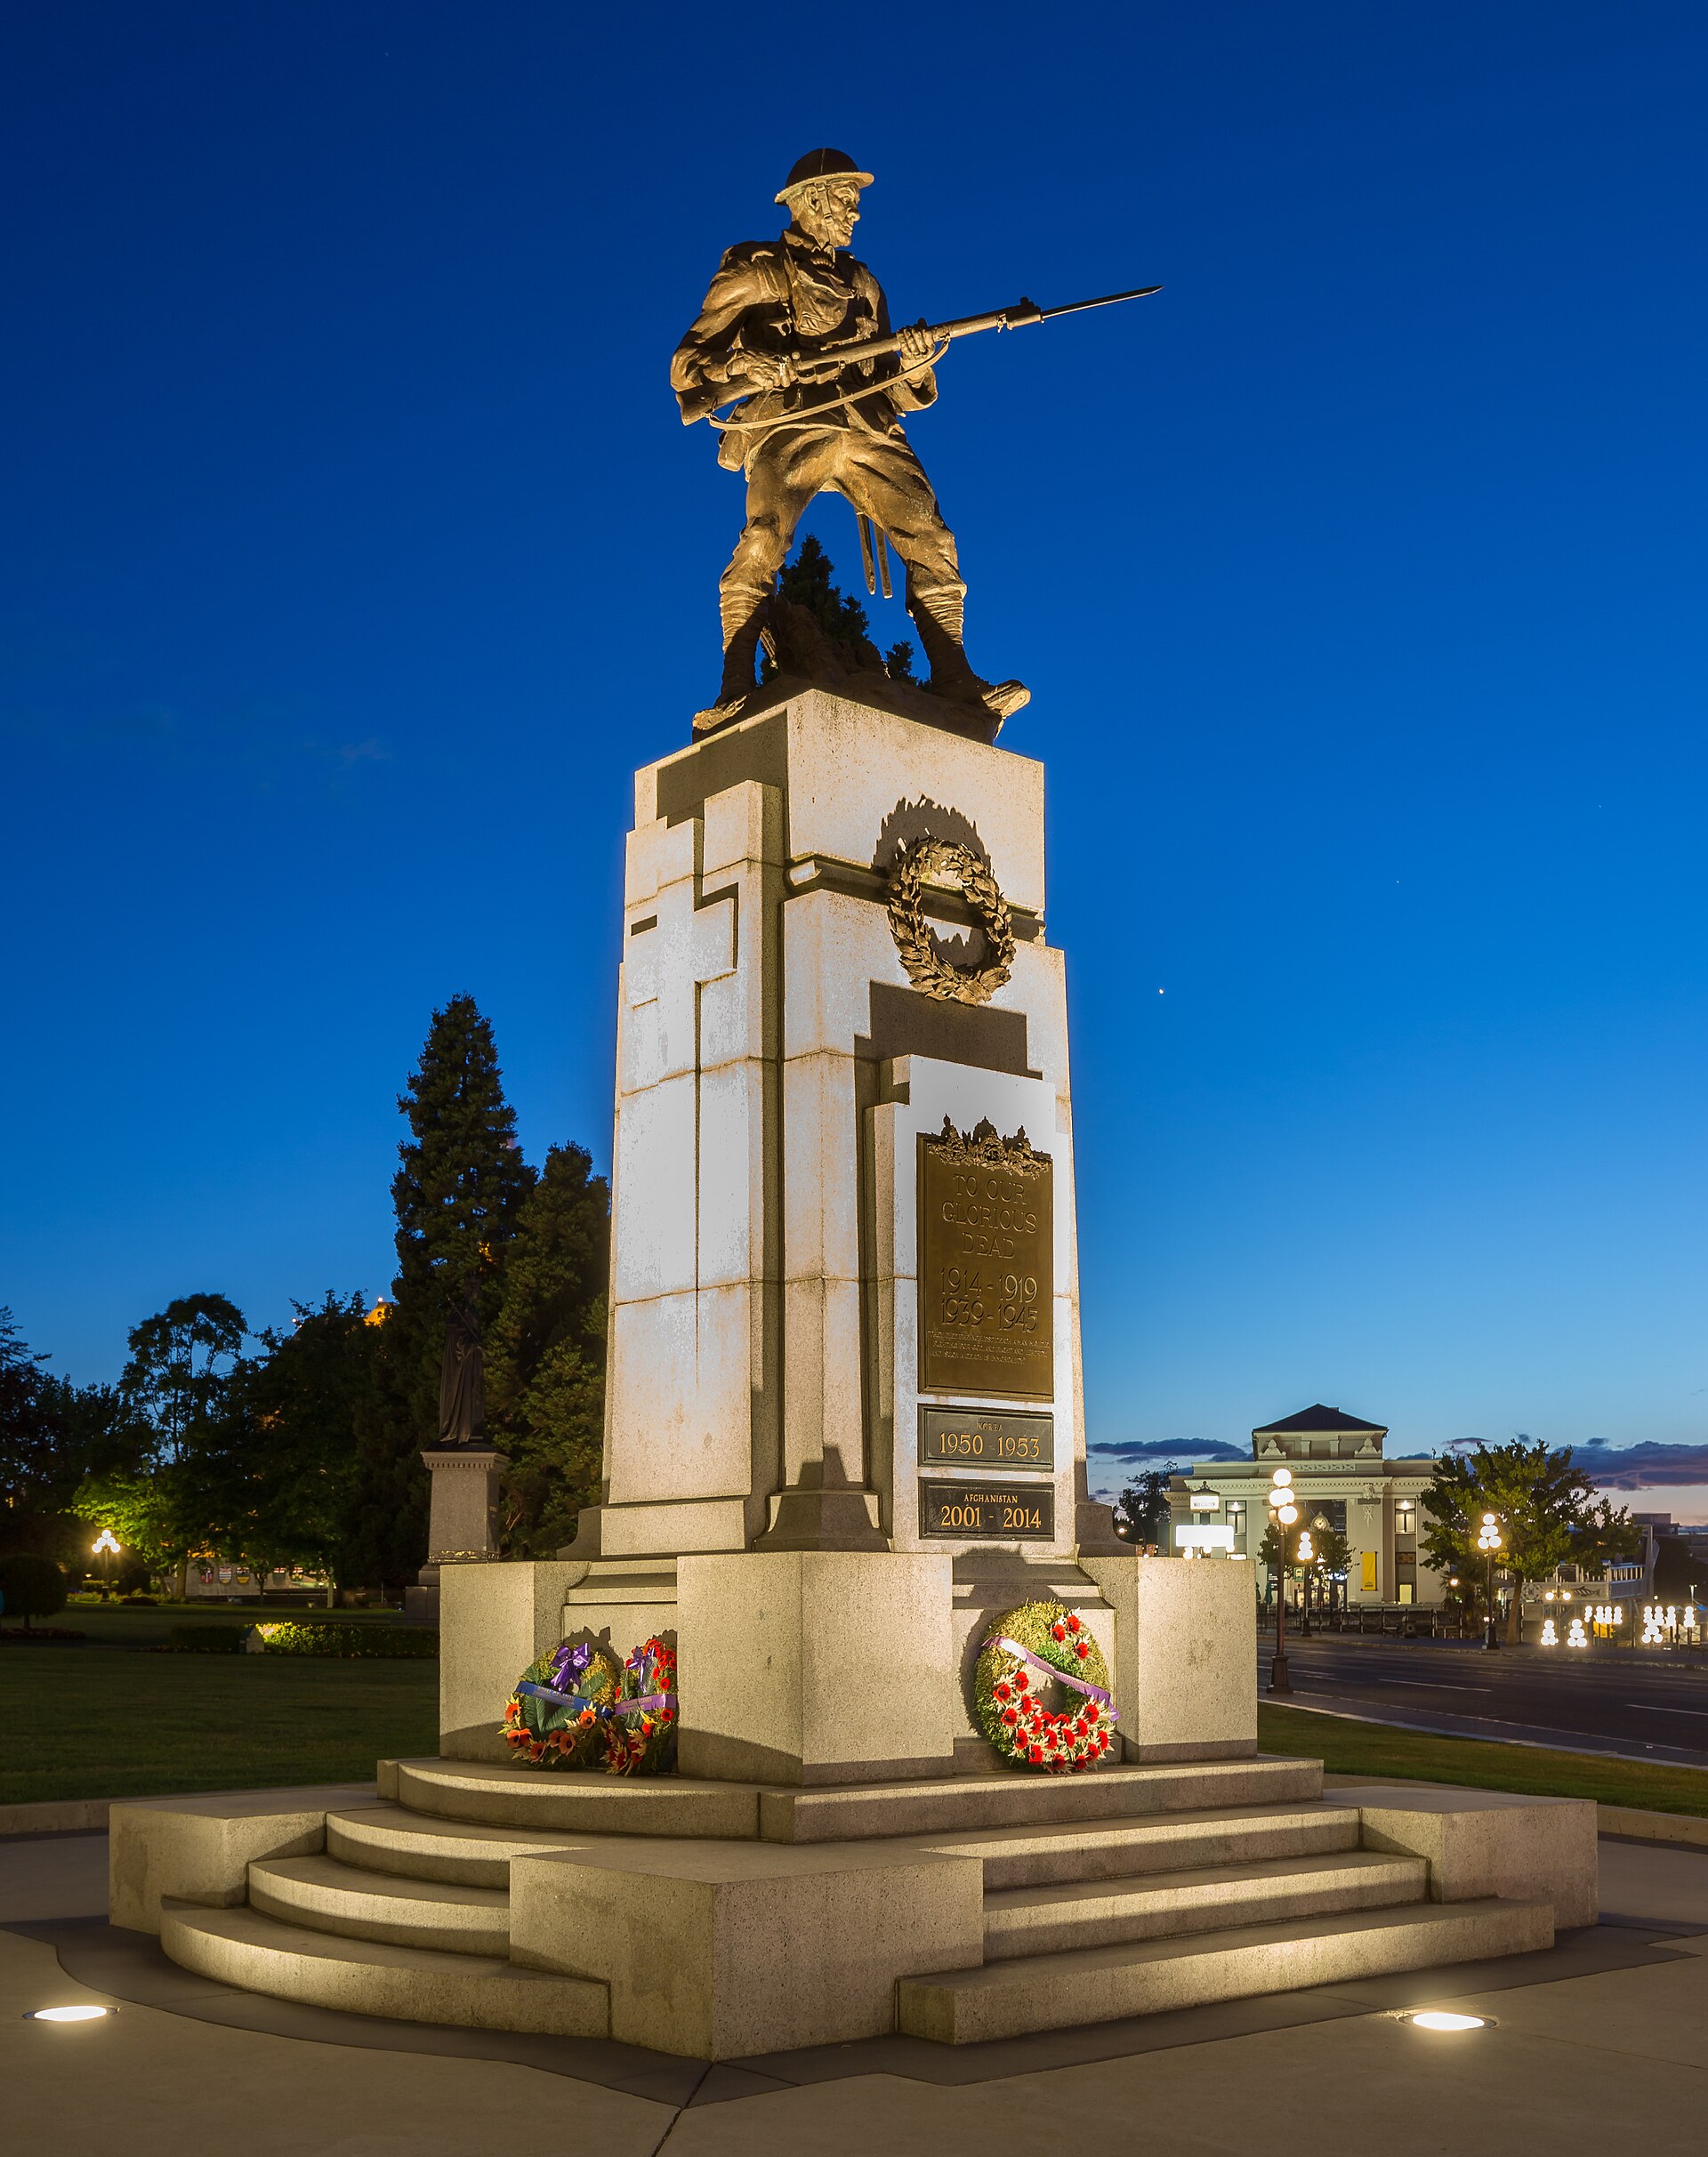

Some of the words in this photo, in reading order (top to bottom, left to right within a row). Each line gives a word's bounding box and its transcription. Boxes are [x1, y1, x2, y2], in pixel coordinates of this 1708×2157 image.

[953, 1174, 978, 1197] TO
[987, 1179, 1027, 1205] OUR
[942, 1201, 1037, 1234] GLORIOUS
[962, 1232, 1015, 1259] DEAD
[941, 1268, 982, 1298] 1914
[999, 1274, 1038, 1303] 1919
[941, 1297, 985, 1327] 1939
[998, 1304, 1038, 1333] 1945
[977, 1421, 1003, 1432] KOREA
[940, 1432, 984, 1455] 1950
[997, 1436, 1041, 1458] 1953
[963, 1493, 1018, 1504] AFGHANISTAN
[941, 1505, 981, 1527] 2001
[1003, 1508, 1042, 1529] 2014
